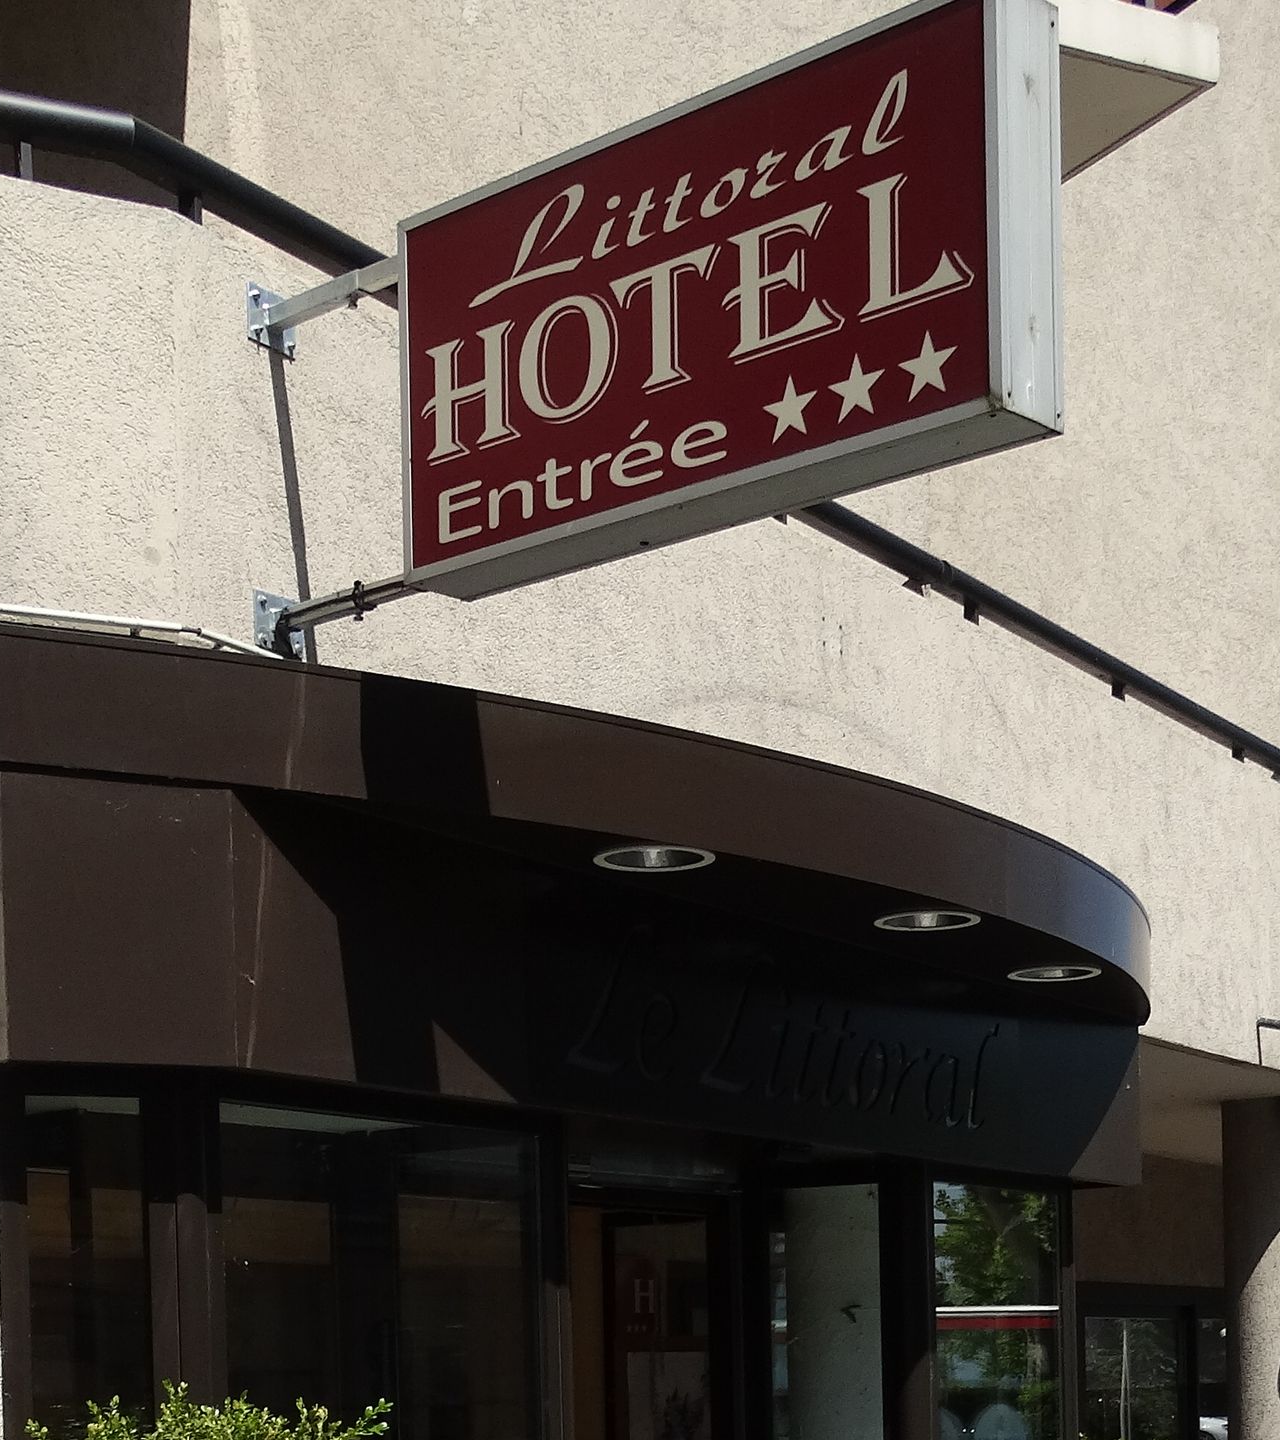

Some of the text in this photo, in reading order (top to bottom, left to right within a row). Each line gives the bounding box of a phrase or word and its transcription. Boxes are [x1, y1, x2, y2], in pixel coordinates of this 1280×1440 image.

[469, 68, 908, 308] Littoral
[421, 174, 975, 466] HOTEL
[437, 420, 728, 545] Entrée
